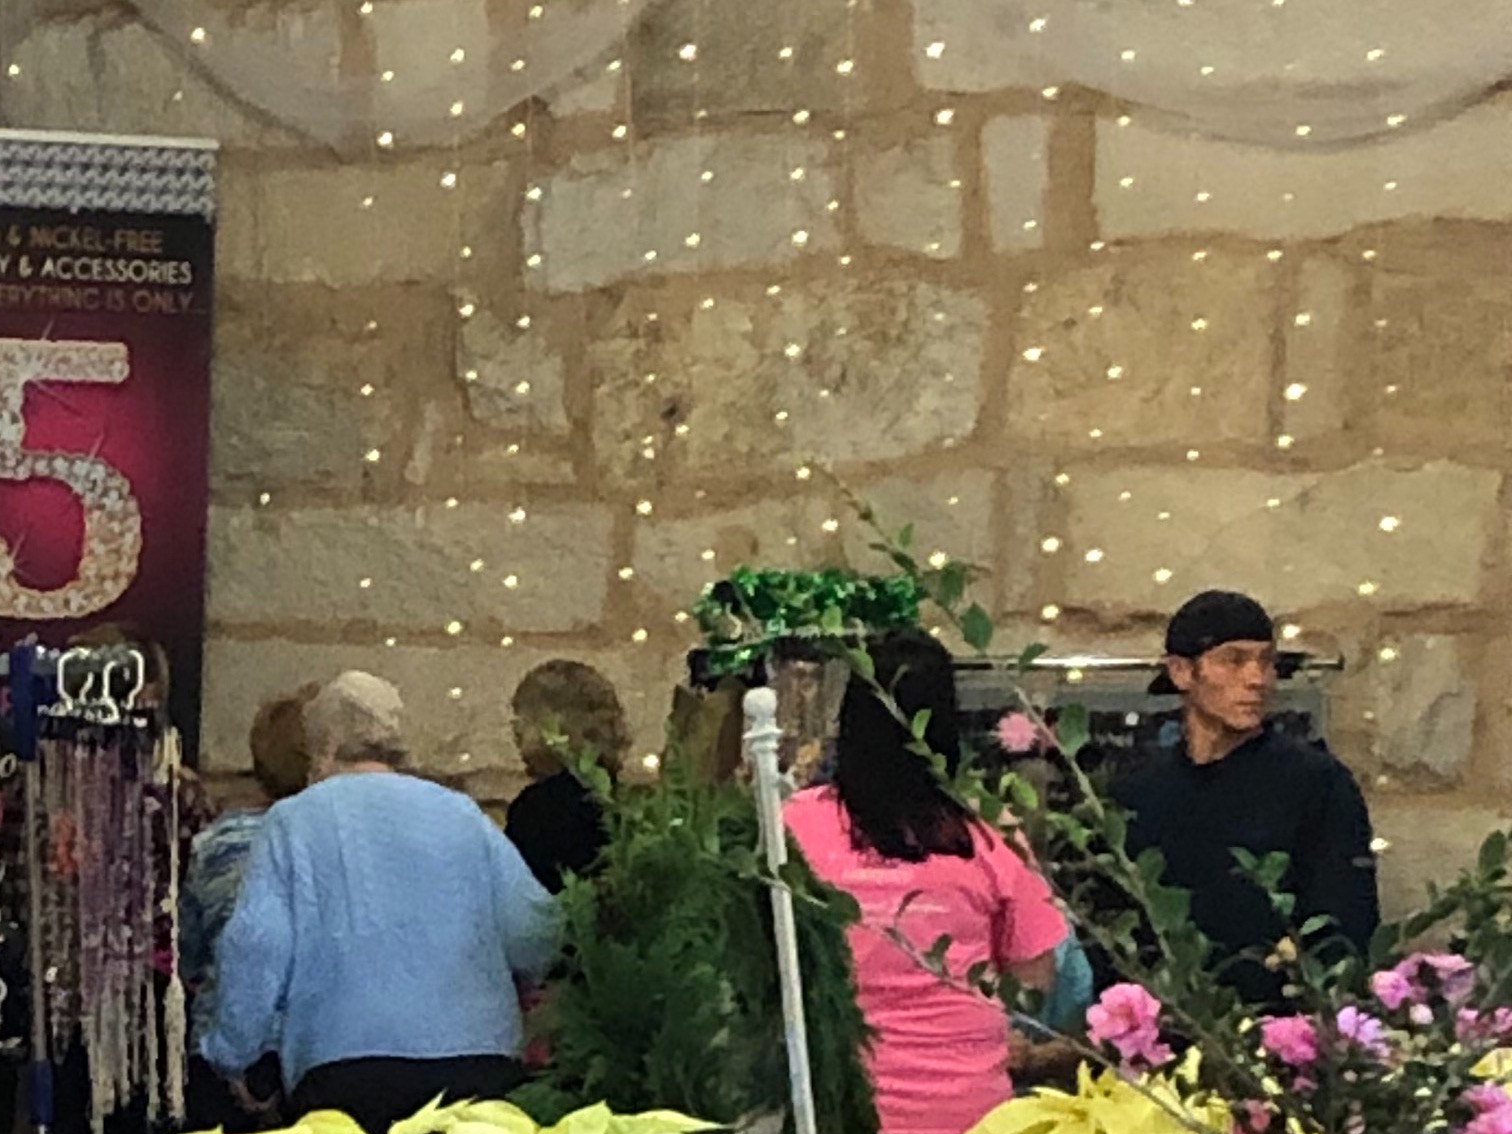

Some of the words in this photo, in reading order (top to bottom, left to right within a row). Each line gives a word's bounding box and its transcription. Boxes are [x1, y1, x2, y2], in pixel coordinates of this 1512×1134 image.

[7, 225, 22, 247] &
[30, 225, 164, 253] NICKEL-FREE
[19, 254, 34, 278] &
[40, 256, 192, 285] ACCESSORIES
[106, 287, 125, 312] IS
